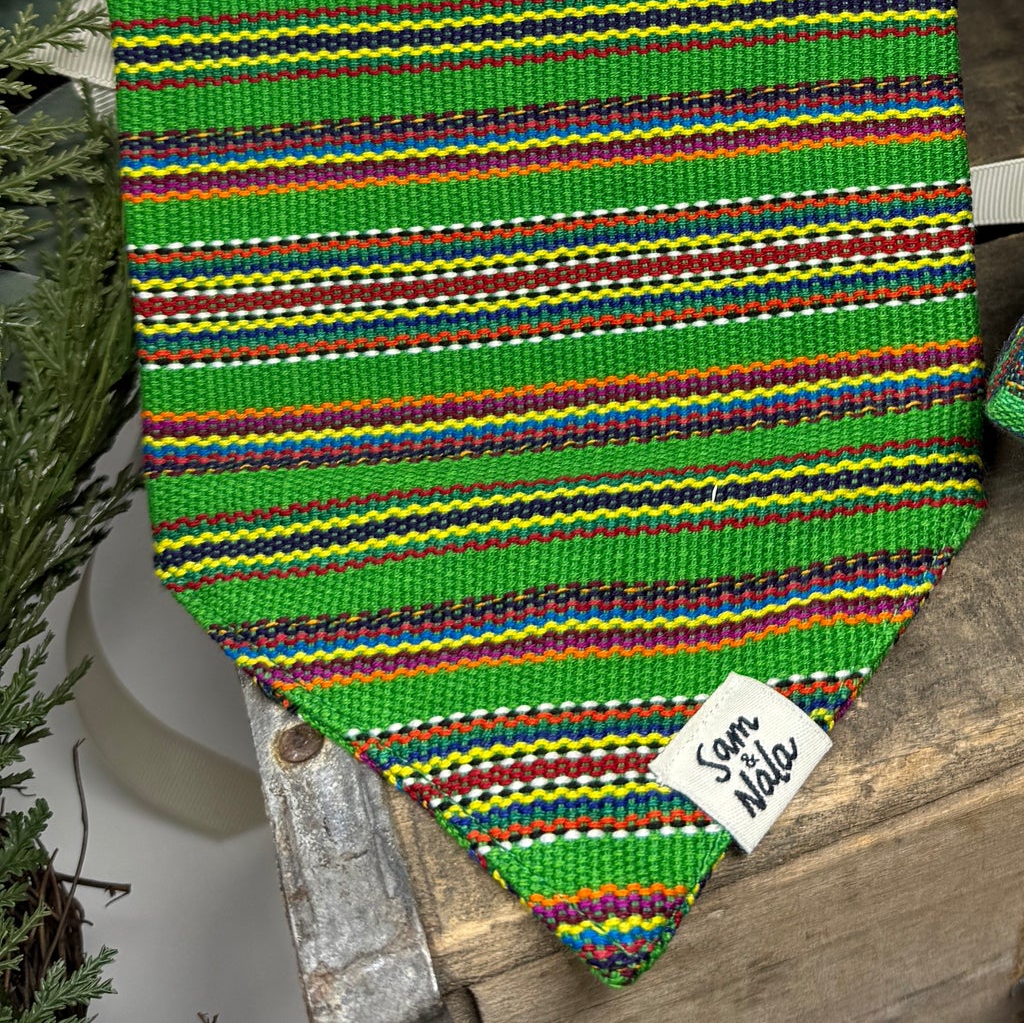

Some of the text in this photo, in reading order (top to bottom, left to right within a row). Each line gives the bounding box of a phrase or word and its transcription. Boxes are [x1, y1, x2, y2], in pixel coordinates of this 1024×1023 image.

[696, 715, 760, 783] Sam
[734, 737, 798, 818] Nala
[740, 753, 760, 767] &
